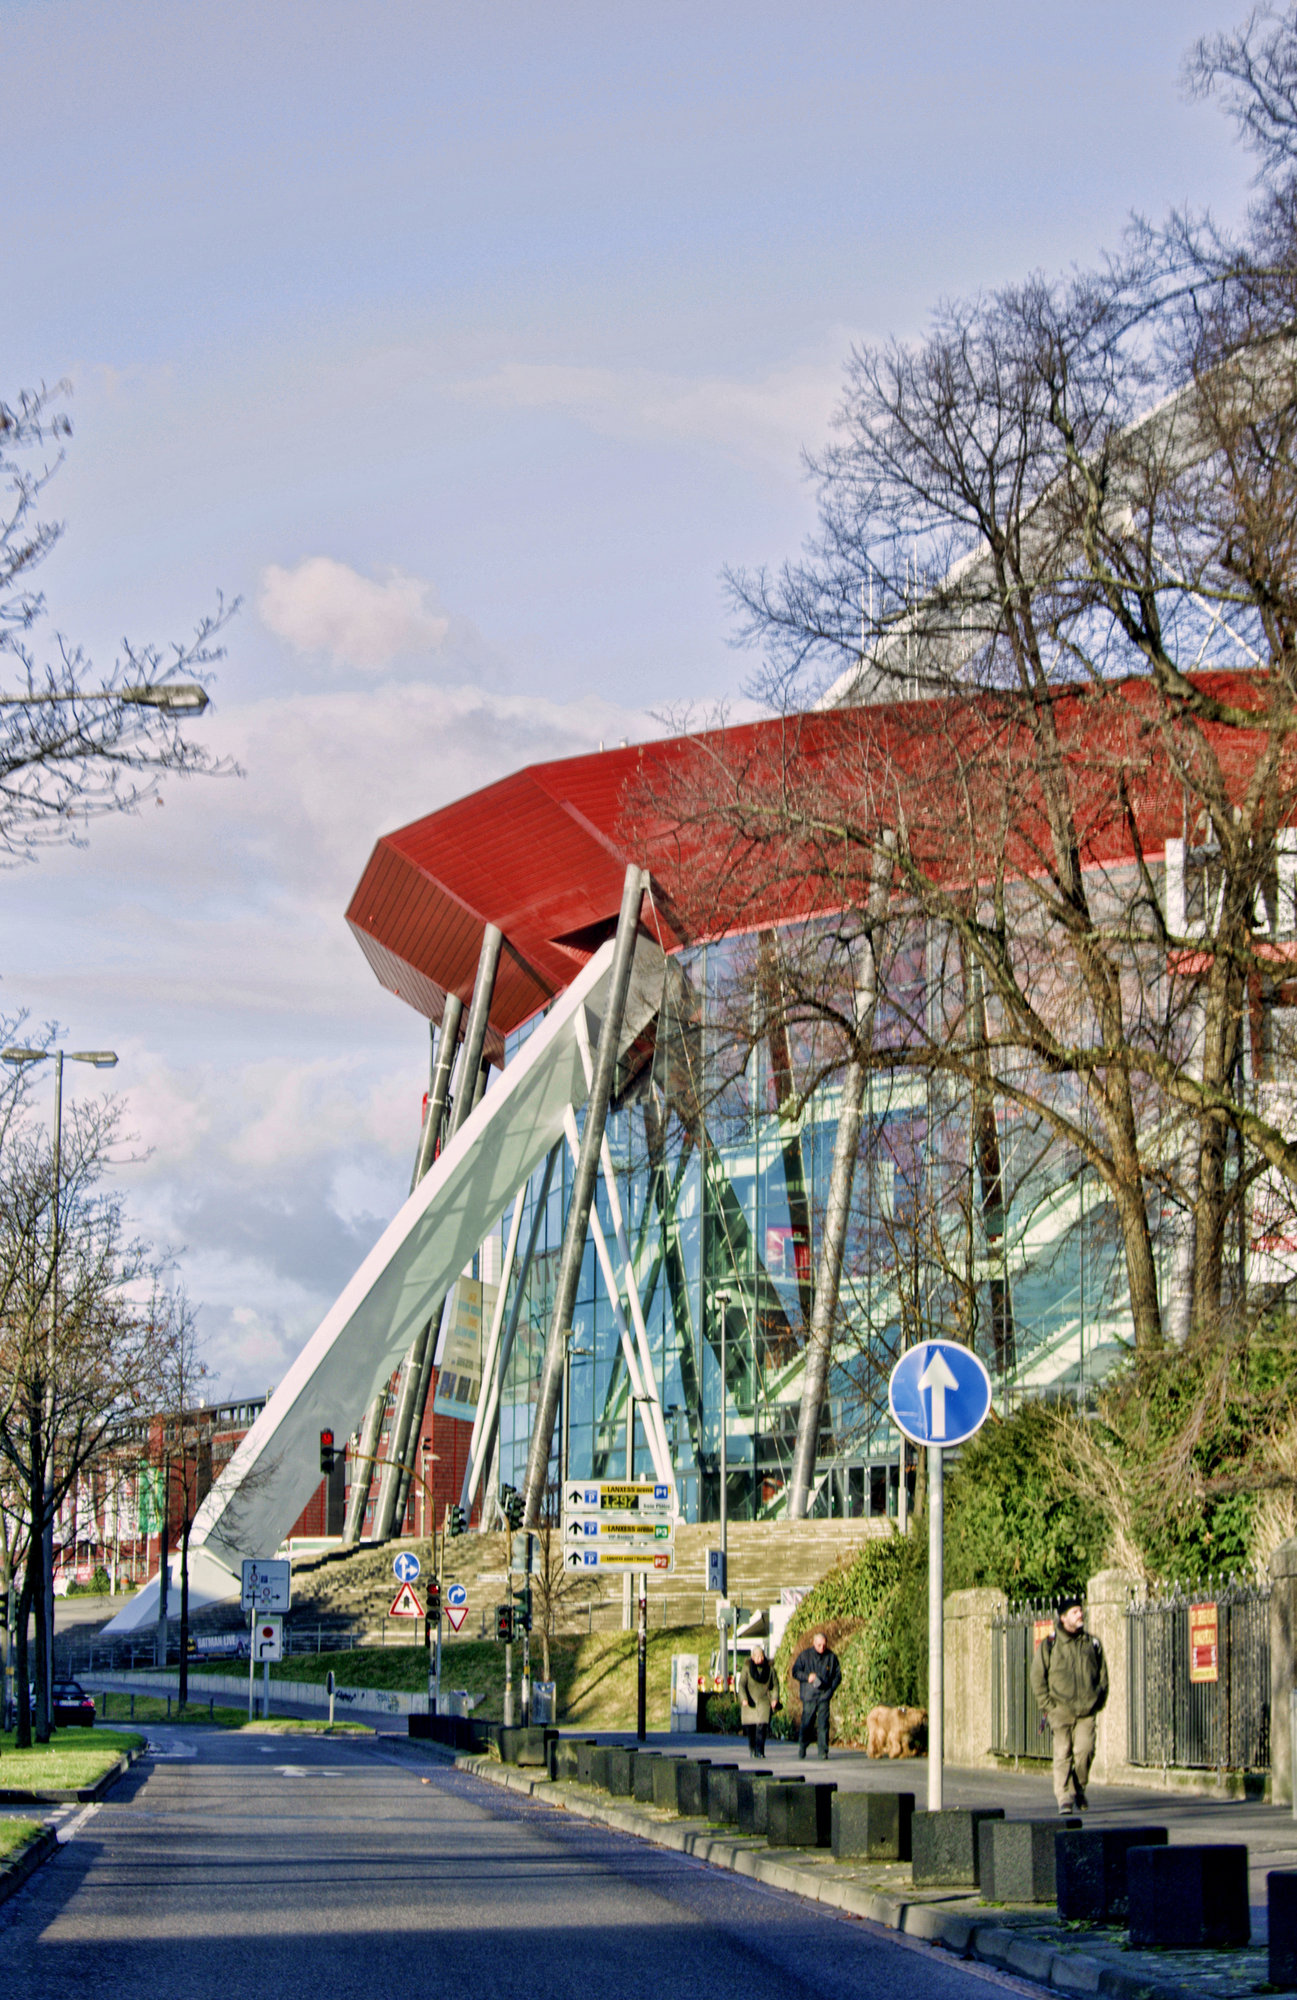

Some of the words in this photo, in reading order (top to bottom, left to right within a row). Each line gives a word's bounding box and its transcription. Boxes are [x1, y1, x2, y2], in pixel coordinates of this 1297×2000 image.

[656, 1488, 667, 1497] P1
[603, 1495, 636, 1508] 1297
[656, 1527, 667, 1536] P3
[655, 1557, 667, 1566] P2
[197, 1636, 222, 1648] BATMAN
[223, 1634, 236, 1646] LIVE
